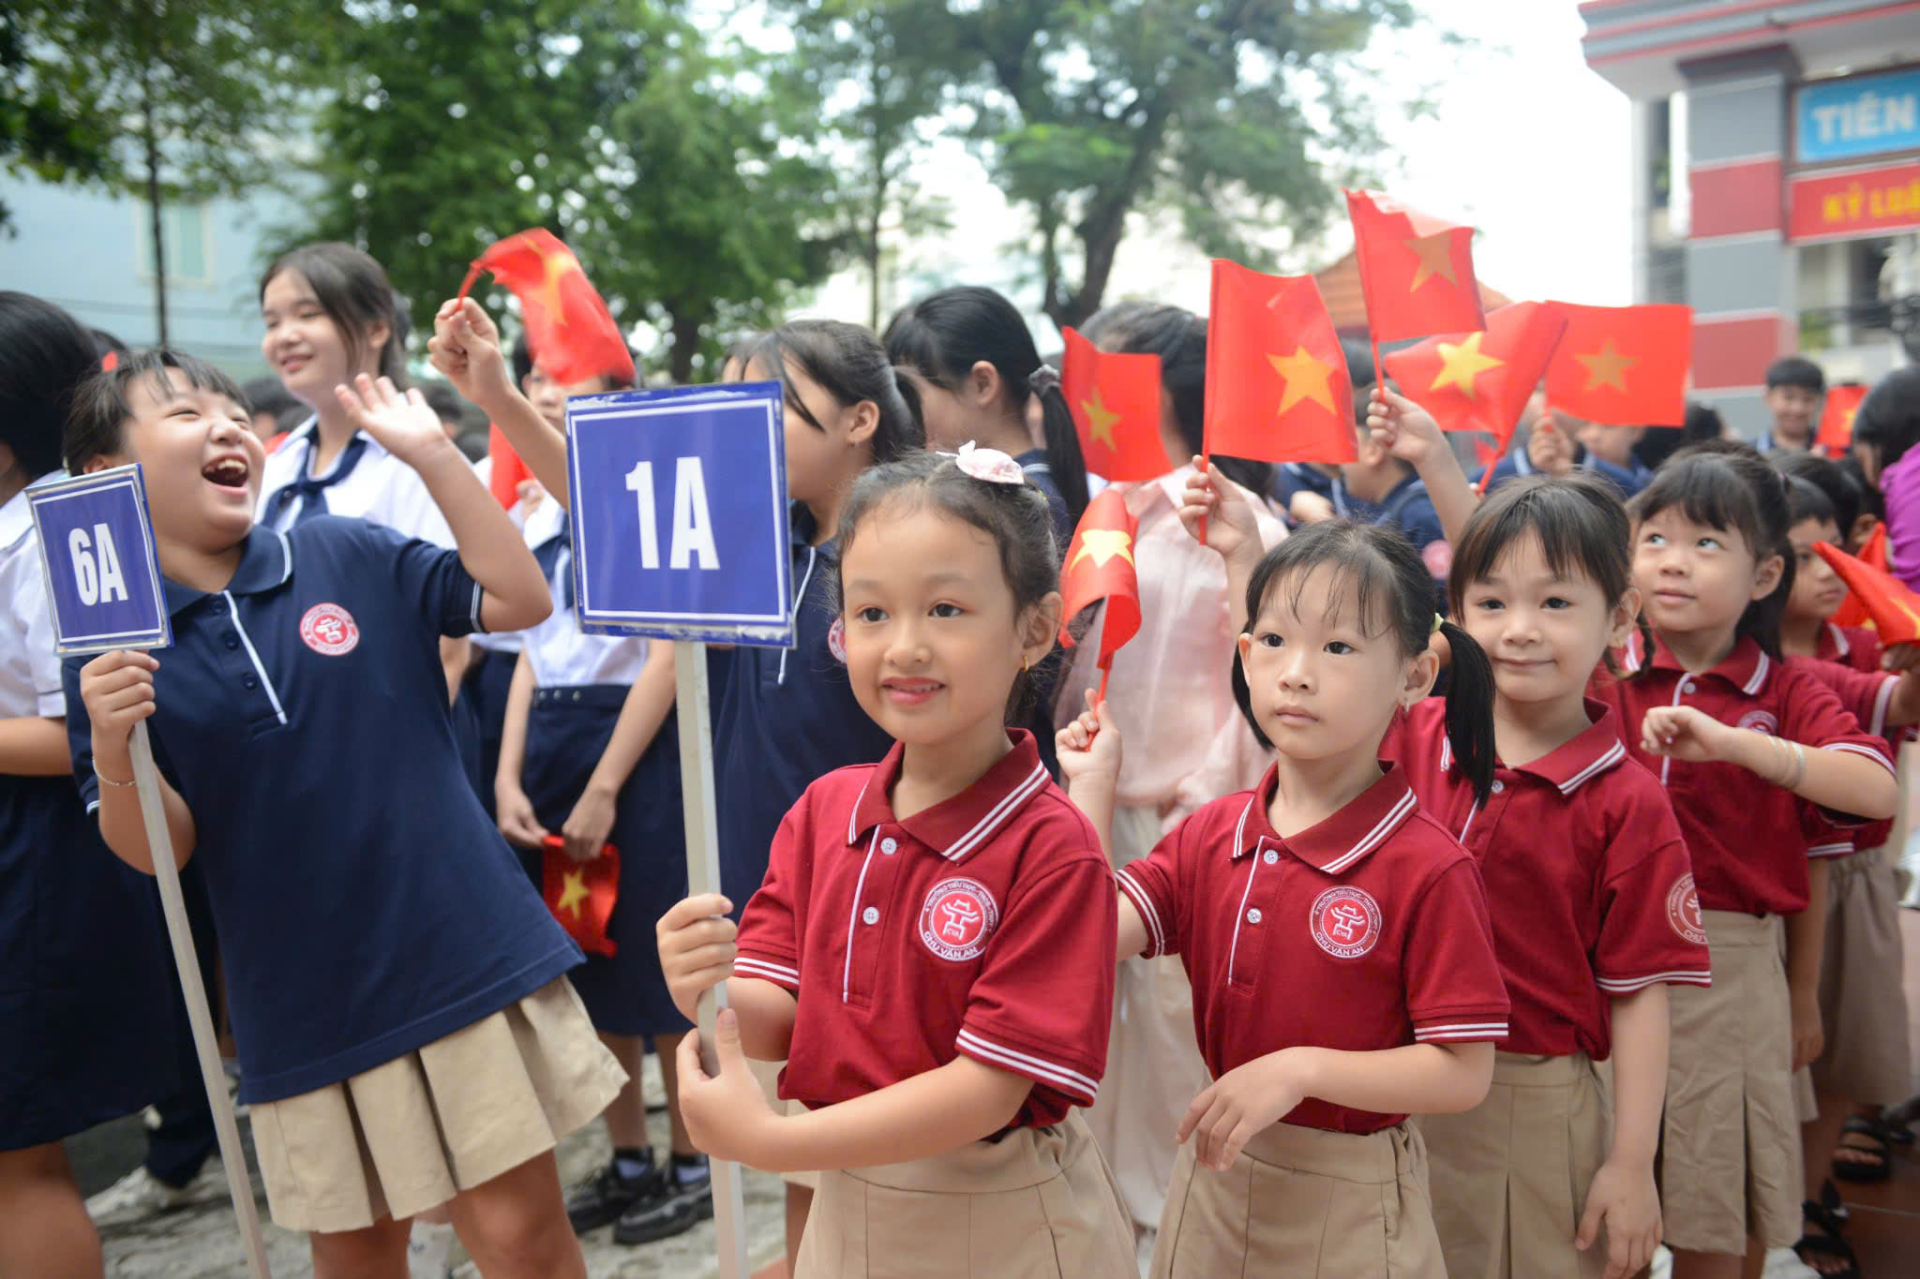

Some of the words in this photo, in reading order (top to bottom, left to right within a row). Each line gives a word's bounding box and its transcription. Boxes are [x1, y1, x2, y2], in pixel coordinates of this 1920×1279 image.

[625, 456, 720, 570] 1A
[68, 523, 128, 606] 6A
[924, 931, 940, 951] CHU
[963, 946, 978, 957] AN
[1316, 931, 1330, 949] CHU
[1350, 946, 1364, 955] AN
